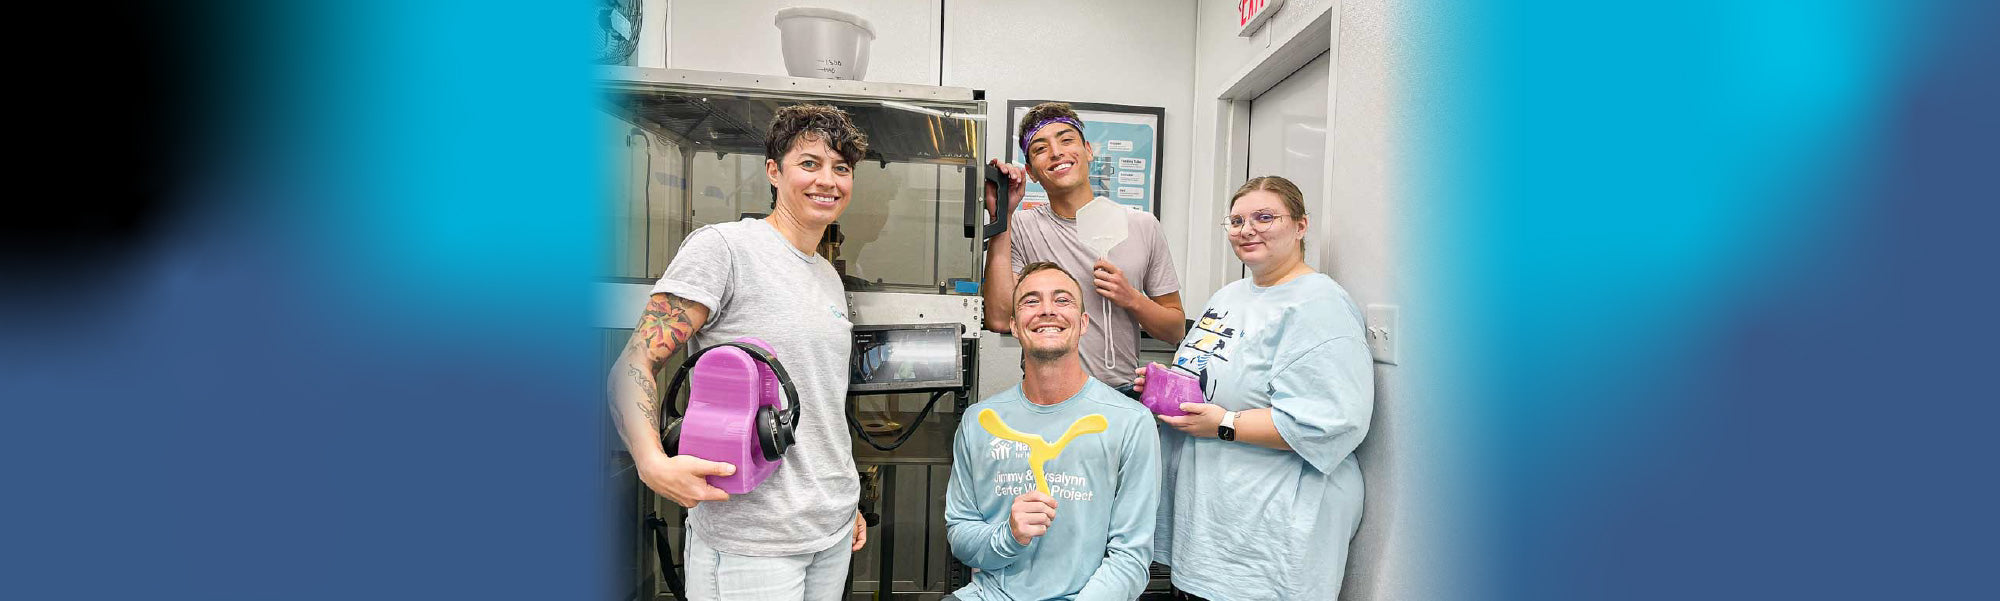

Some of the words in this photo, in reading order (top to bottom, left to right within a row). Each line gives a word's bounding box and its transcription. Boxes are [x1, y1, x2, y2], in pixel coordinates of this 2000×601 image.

[994, 471, 1024, 484] Jimmy
[1025, 469, 1034, 481] &
[1045, 471, 1087, 487] salynn
[994, 484, 1023, 496] Carter
[1051, 484, 1094, 501] Project
